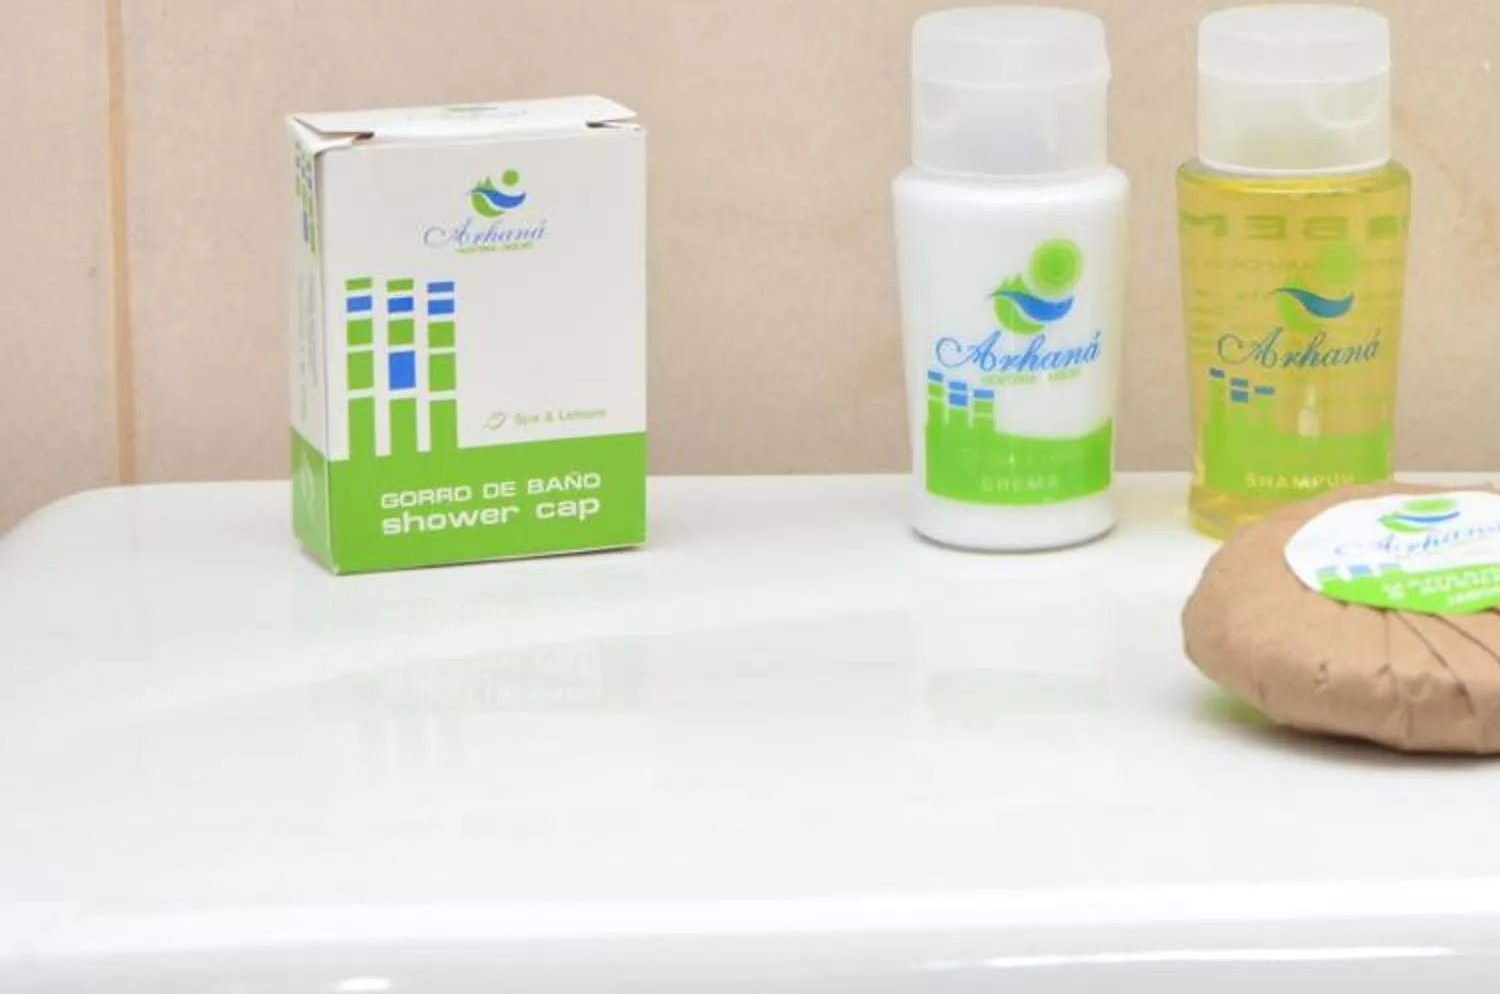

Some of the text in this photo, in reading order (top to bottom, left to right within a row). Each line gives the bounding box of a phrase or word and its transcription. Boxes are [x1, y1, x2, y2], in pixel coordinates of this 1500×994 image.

[1217, 327, 1382, 370] Arhaná
[381, 470, 602, 509] GORRO DE BAÑO
[382, 497, 601, 536] shower cap
